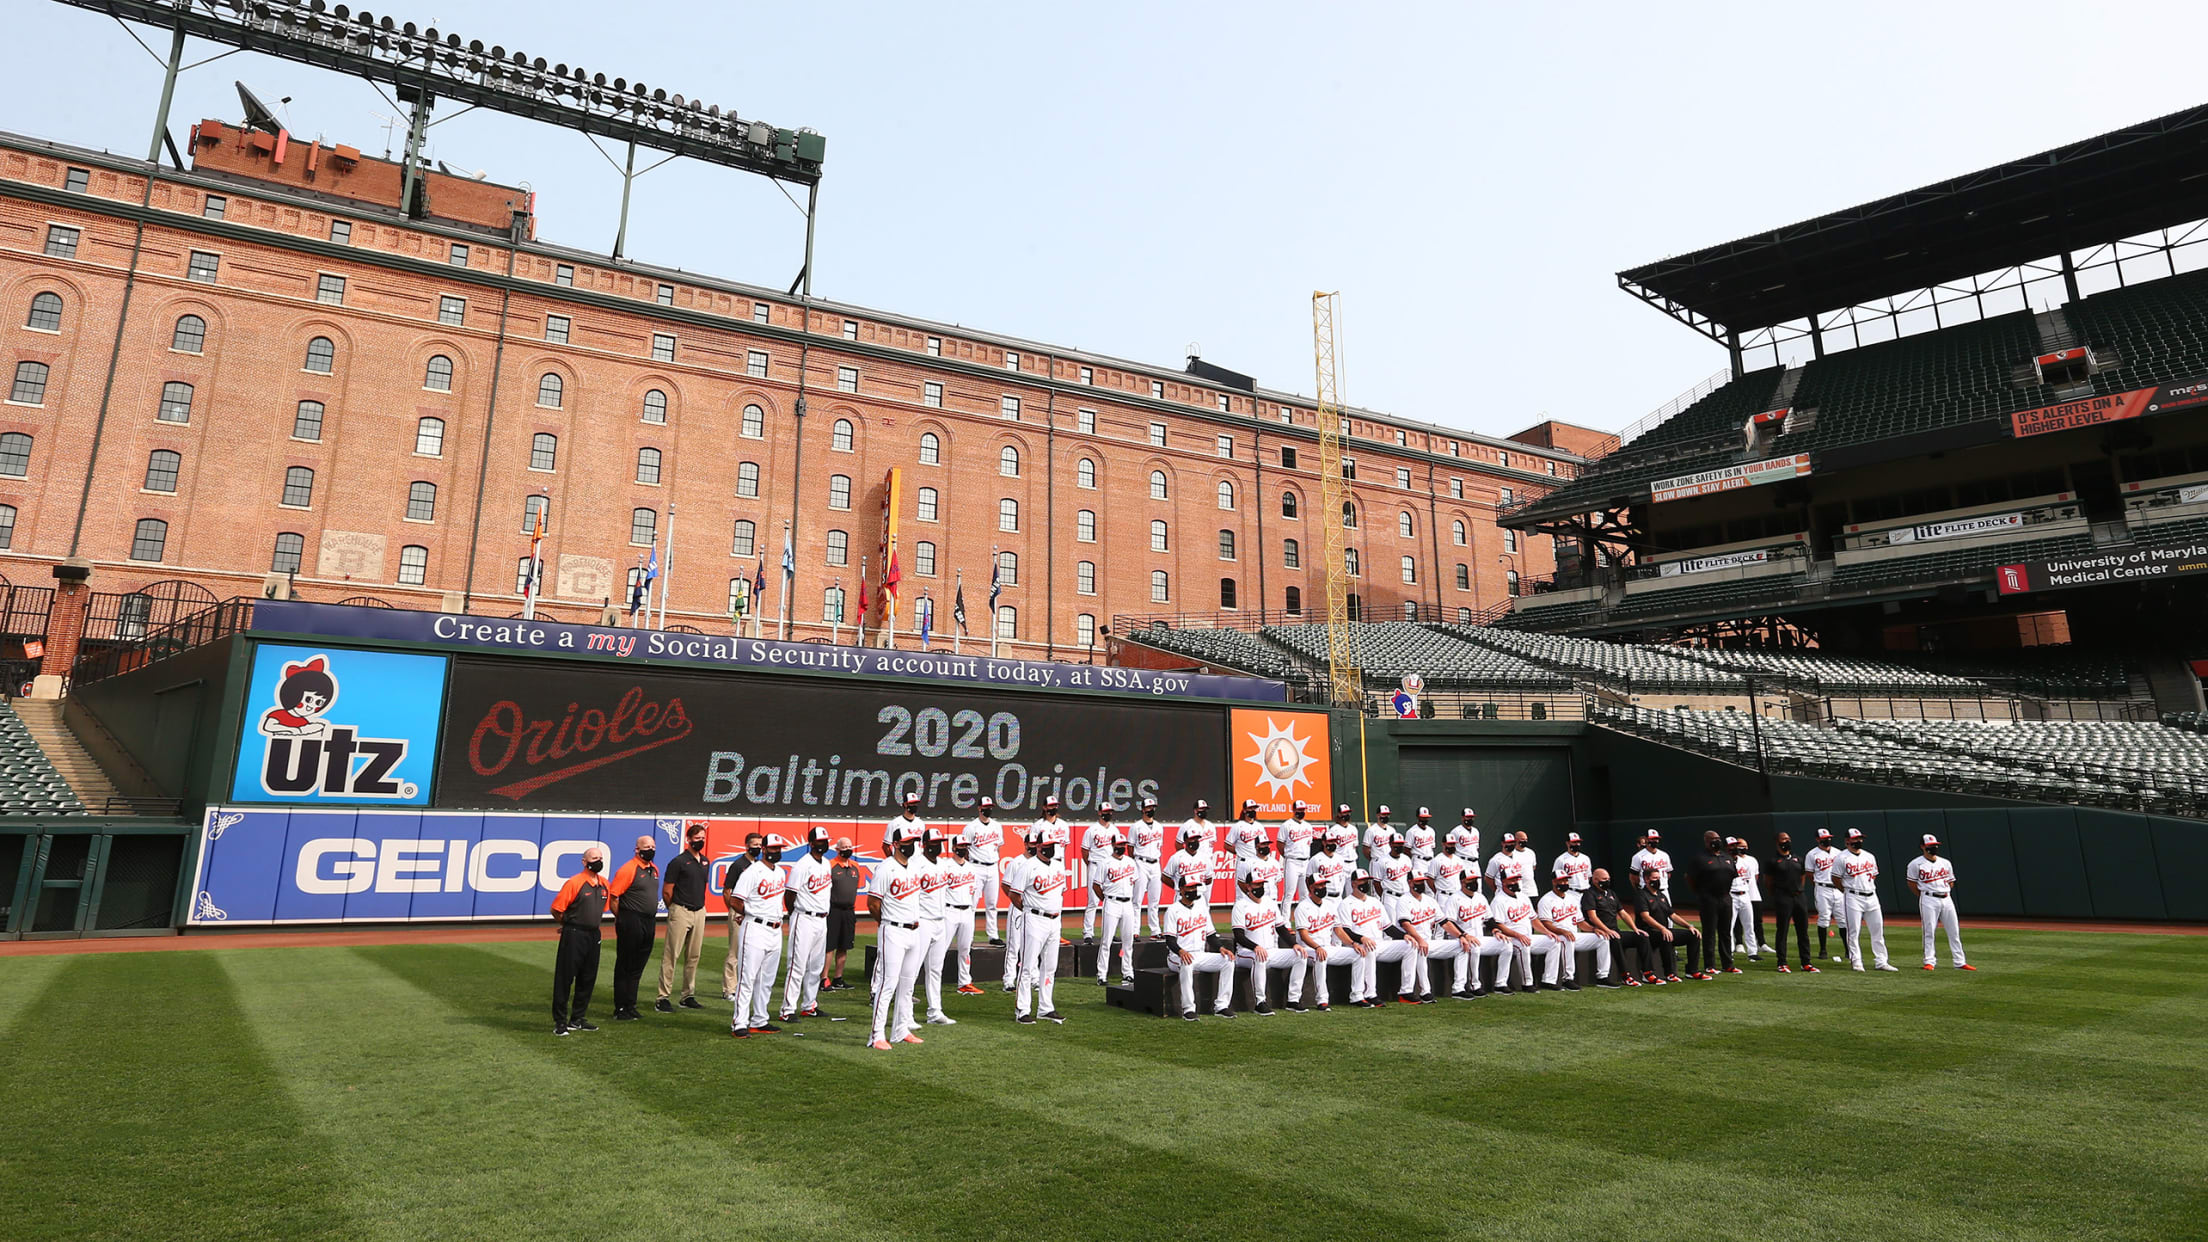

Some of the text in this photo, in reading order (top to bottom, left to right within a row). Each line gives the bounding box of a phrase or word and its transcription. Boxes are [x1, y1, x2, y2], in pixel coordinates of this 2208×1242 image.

[2043, 402, 2090, 421] ALERTS
[2094, 398, 2112, 410] ON
[2115, 396, 2125, 406] A
[2021, 411, 2111, 435] HIGHER LEVEL.
[1653, 458, 1793, 491] WORK ZONE SAFETY IS IN YOUR HANDS.
[1655, 491, 1675, 502] SLOW
[1702, 483, 1720, 494] STAY
[1945, 522, 1975, 533] FLITE
[1978, 517, 2007, 528] DECK
[1705, 558, 1728, 568] FLITE
[1732, 554, 1754, 563] DECK
[2047, 545, 2208, 573] University of Maryla
[2050, 564, 2168, 586] Medical Center
[433, 615, 1190, 695] Create a my Social Security account today, at SSA.gov
[469, 686, 693, 778] Orioles
[877, 704, 1021, 760] 2020
[1278, 748, 1289, 767] L
[703, 750, 1160, 811] Baltimore Orioles
[296, 838, 611, 895] GEICO
[1919, 867, 1950, 880] Orioles
[1177, 914, 1207, 933] Orioles
[1245, 909, 1276, 928] Orioles
[1351, 906, 1381, 923] Orioles
